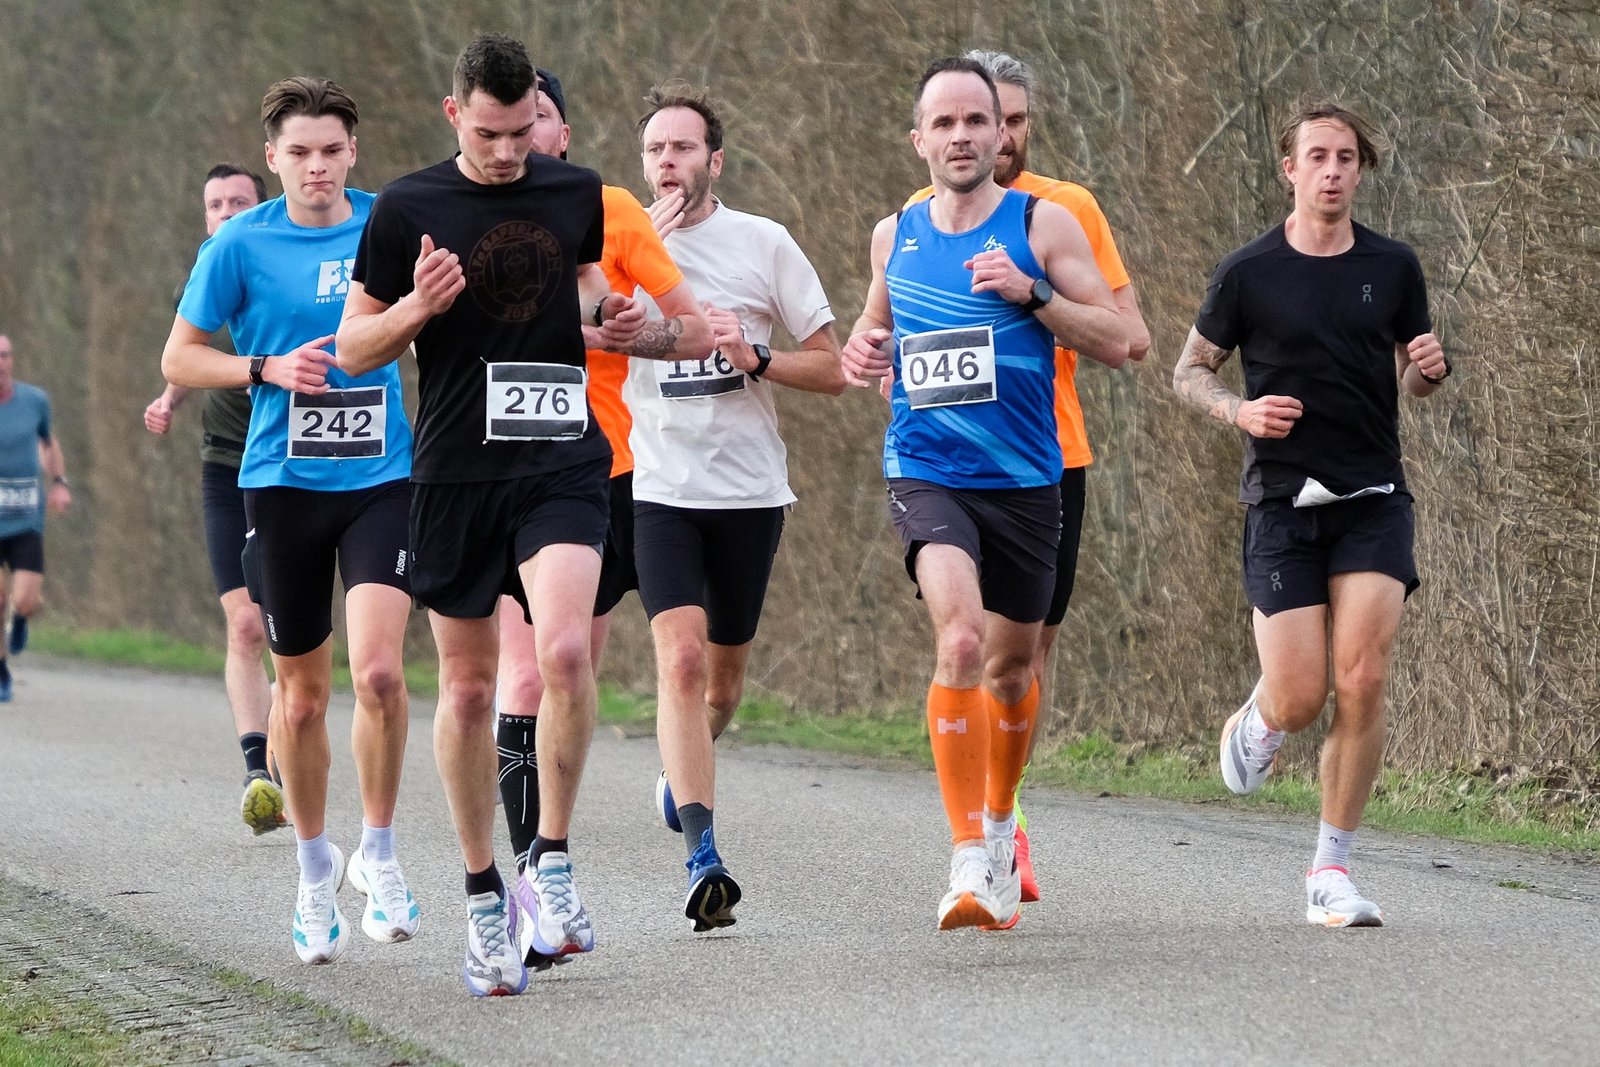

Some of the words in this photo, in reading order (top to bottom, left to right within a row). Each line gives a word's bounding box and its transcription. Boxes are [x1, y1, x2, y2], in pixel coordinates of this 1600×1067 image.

[909, 351, 980, 385] 046
[505, 386, 570, 415] 276
[301, 409, 372, 438] 242
[395, 549, 407, 576] FUSION
[266, 613, 278, 642] FUSION
